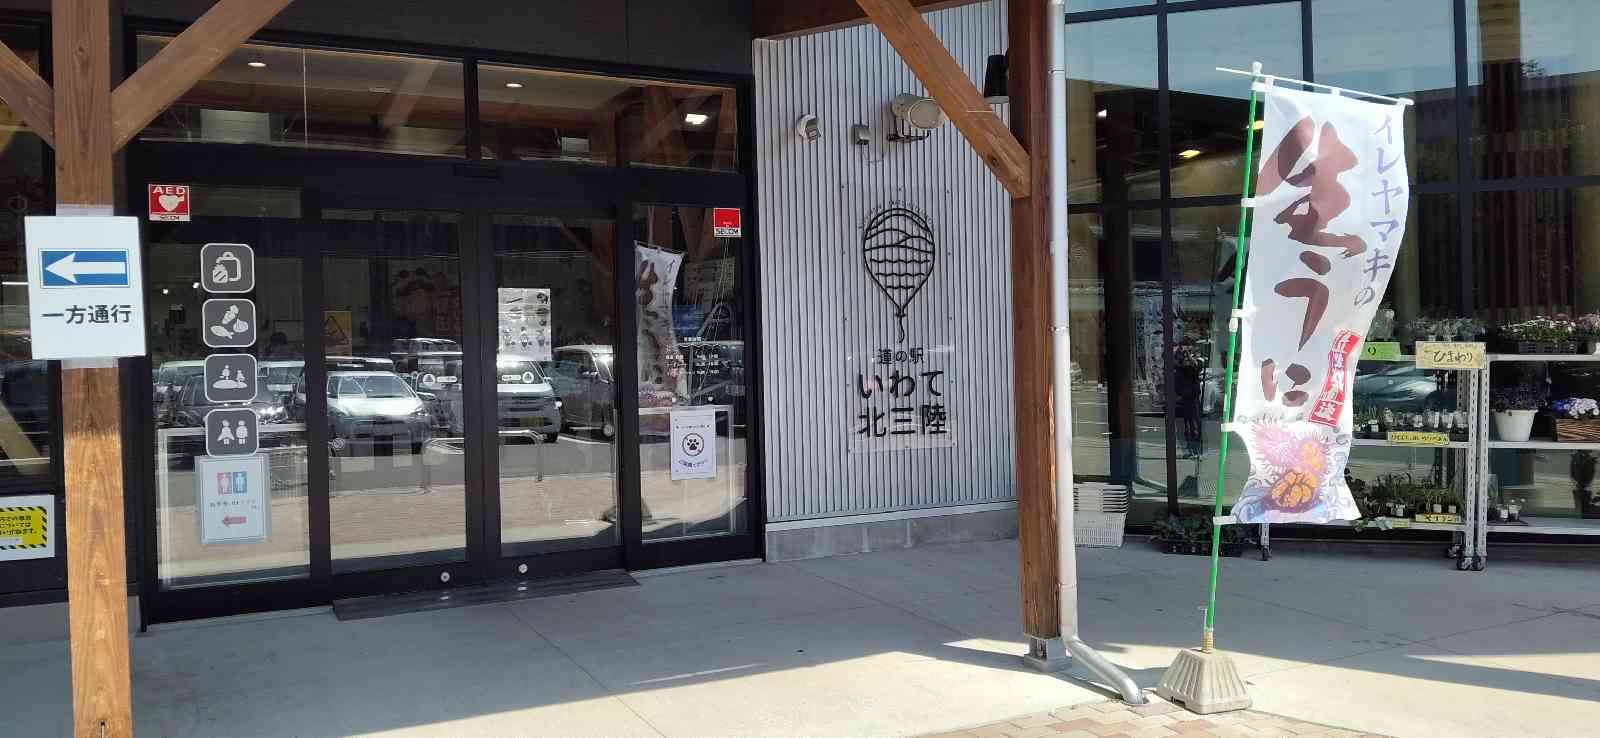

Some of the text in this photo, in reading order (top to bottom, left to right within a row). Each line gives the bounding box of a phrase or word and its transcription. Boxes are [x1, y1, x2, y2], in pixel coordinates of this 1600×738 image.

[152, 186, 186, 195] AED
[1354, 113, 1404, 307] イレヤマキの
[1255, 114, 1368, 408] 生うに
[41, 304, 132, 325] 一方通行
[878, 347, 925, 365] 道の駅
[1433, 350, 1474, 363] ひまわり
[858, 369, 945, 400] いわて
[857, 402, 948, 438] 北三陸
